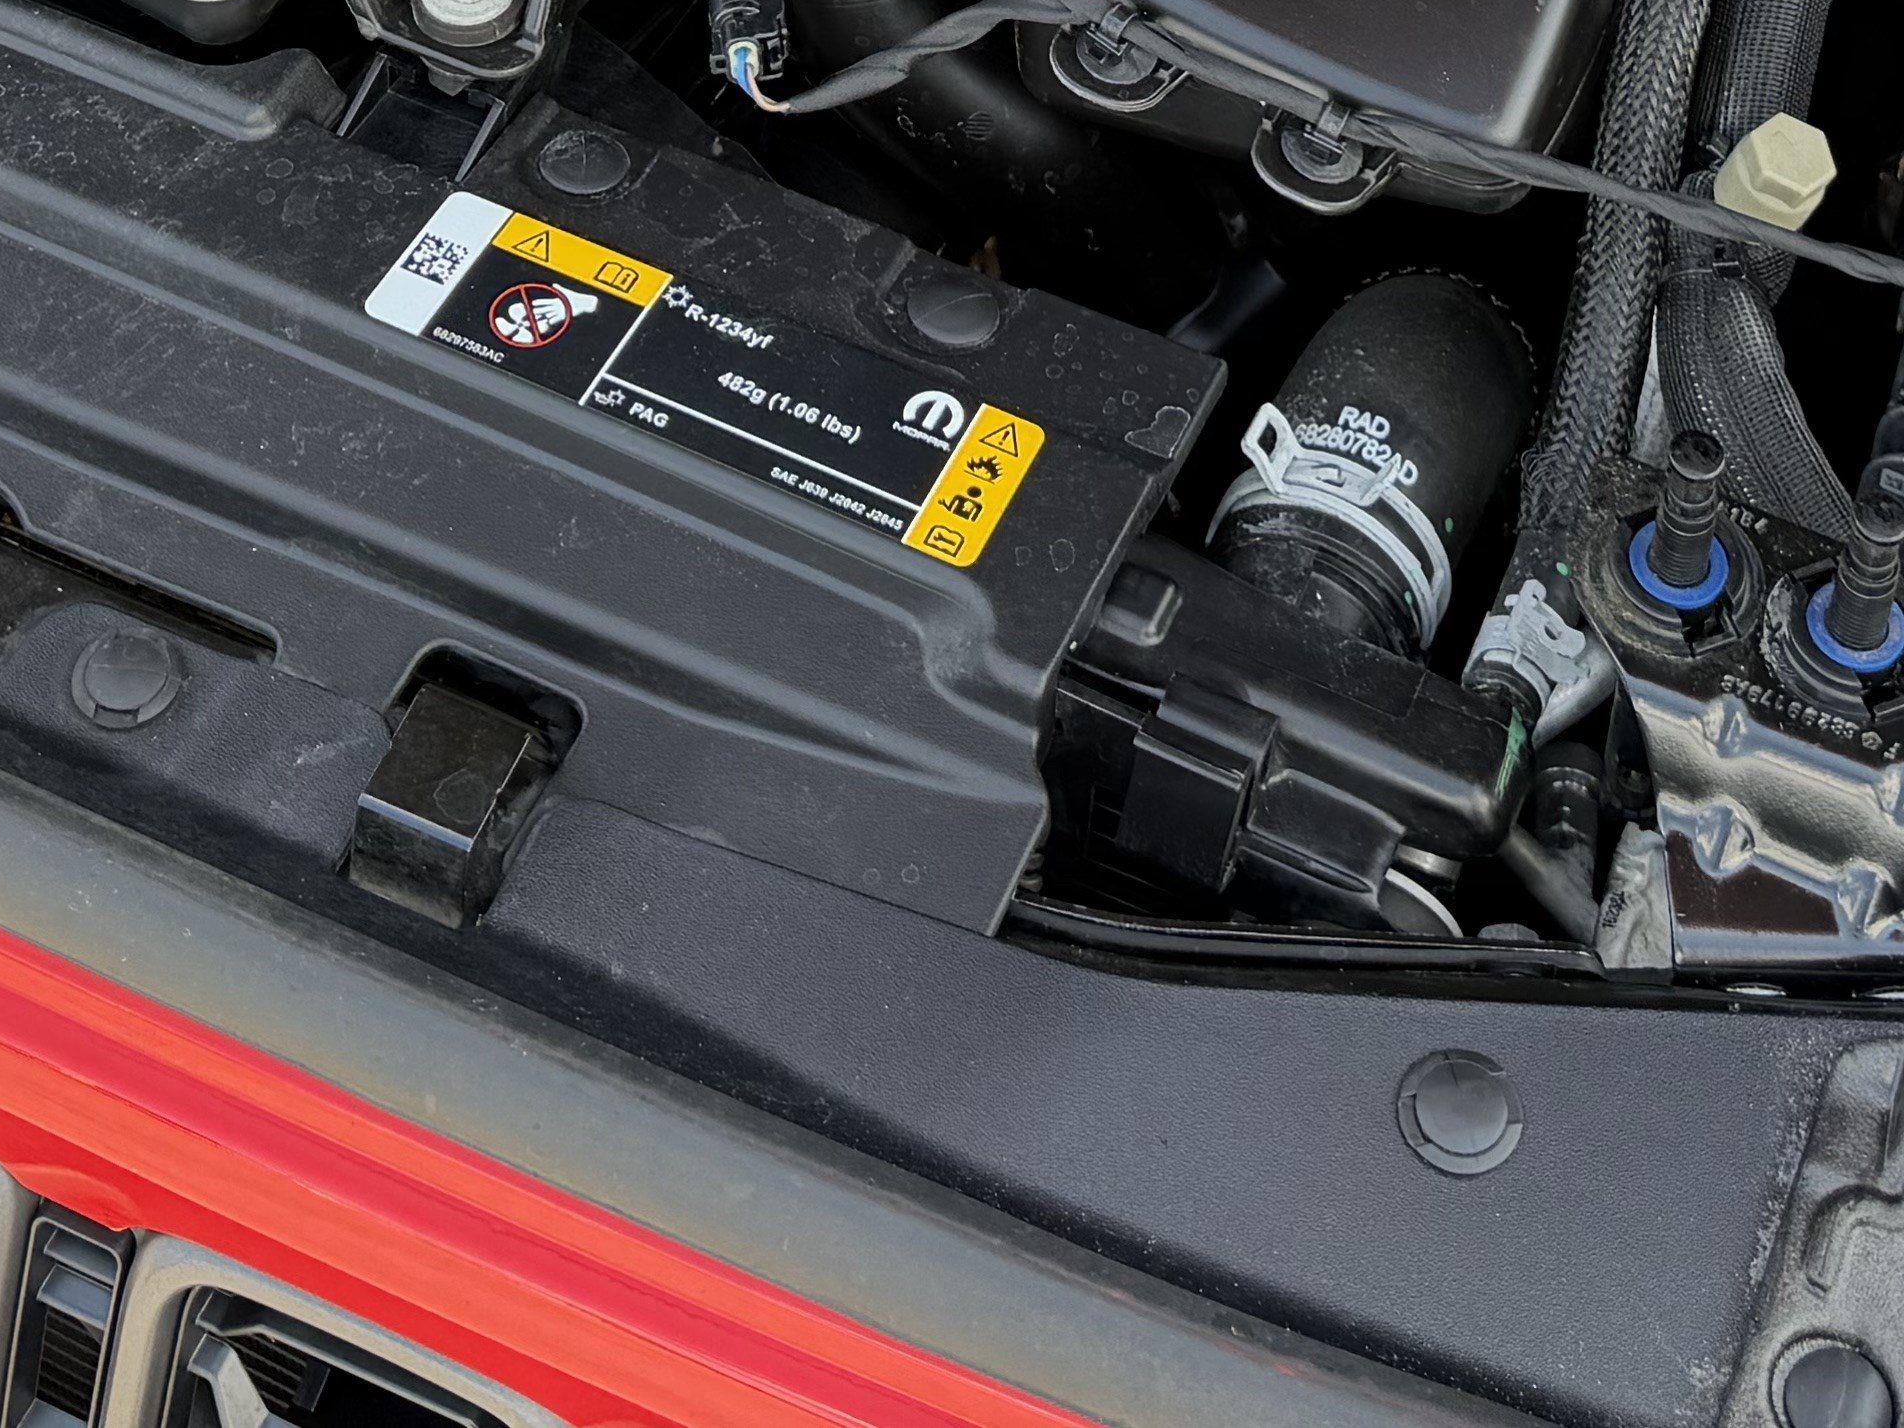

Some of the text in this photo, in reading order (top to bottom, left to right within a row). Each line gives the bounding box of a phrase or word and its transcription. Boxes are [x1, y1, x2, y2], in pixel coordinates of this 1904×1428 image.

[684, 303, 774, 349] R-1234yf
[629, 401, 670, 428] PAG
[717, 371, 862, 445] 482g (1.06 lbs)
[1338, 405, 1391, 440] RAD
[1295, 423, 1418, 486] 68280782AD
[770, 465, 799, 487] SAE
